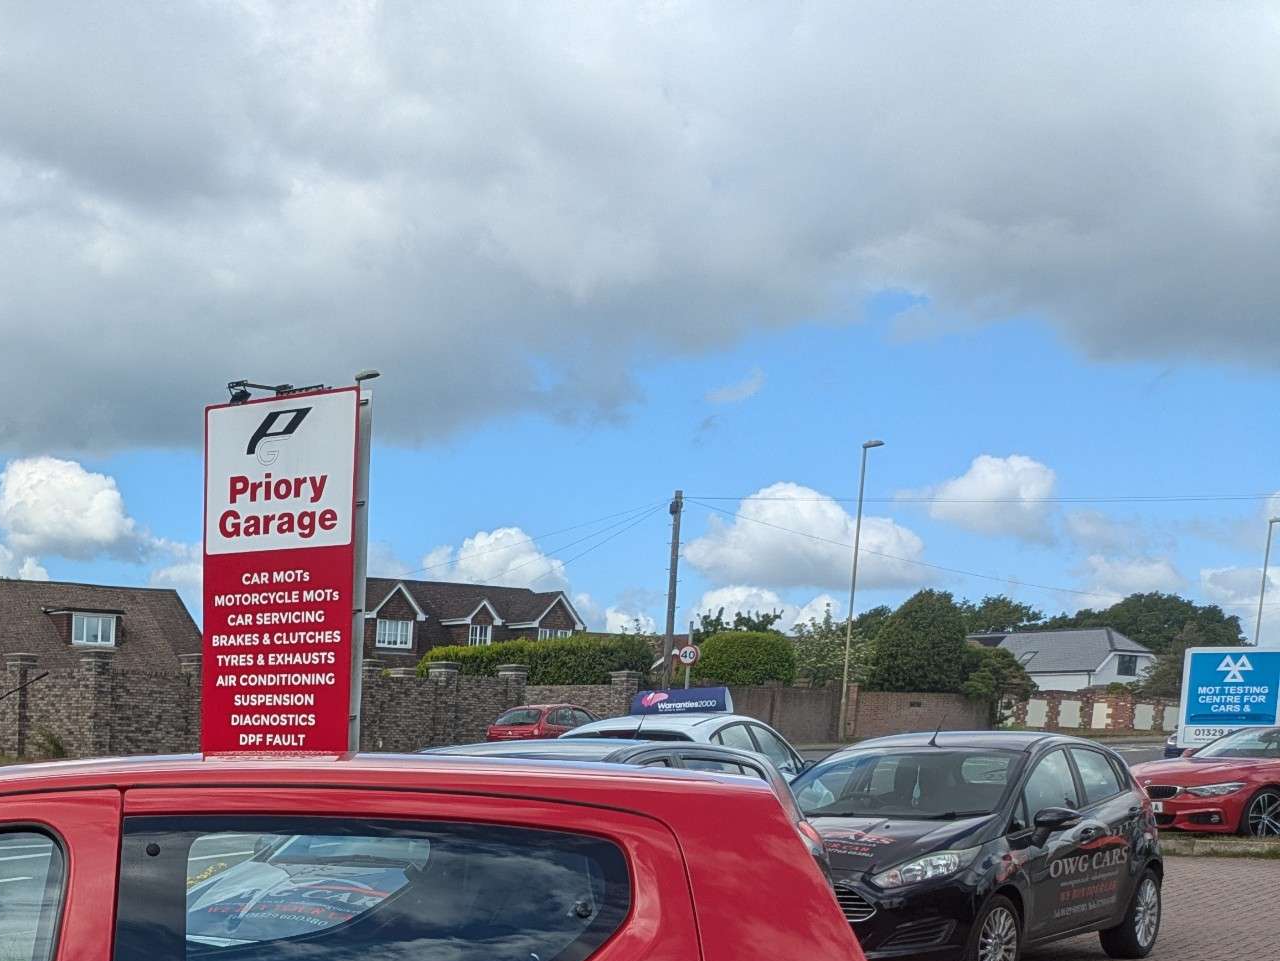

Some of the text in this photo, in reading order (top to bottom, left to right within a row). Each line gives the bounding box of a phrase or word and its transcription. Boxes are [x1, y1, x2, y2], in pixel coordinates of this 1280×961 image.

[229, 473, 328, 504] Priory
[219, 508, 338, 538] Garage
[241, 570, 310, 585] CAR MOTs
[214, 589, 339, 607] MOTORCYCLE MOTs
[227, 611, 325, 626] CAR SERVICING
[212, 631, 341, 646] BRAKES & CLUTCHES
[216, 652, 335, 666] TYRES & EXHAUSTS
[681, 650, 695, 659] 40
[216, 673, 335, 687] AIR CONDITIONING
[1197, 686, 1269, 694] MOT TESTING
[234, 694, 314, 706] SUSPENSION
[1198, 695, 1266, 704] CENTRE FOR
[231, 714, 315, 726] DIAGNOSTICS
[1194, 728, 1224, 737] 01329
[239, 734, 305, 746] DPF FAULT
[1050, 847, 1128, 878] OWG CARS
